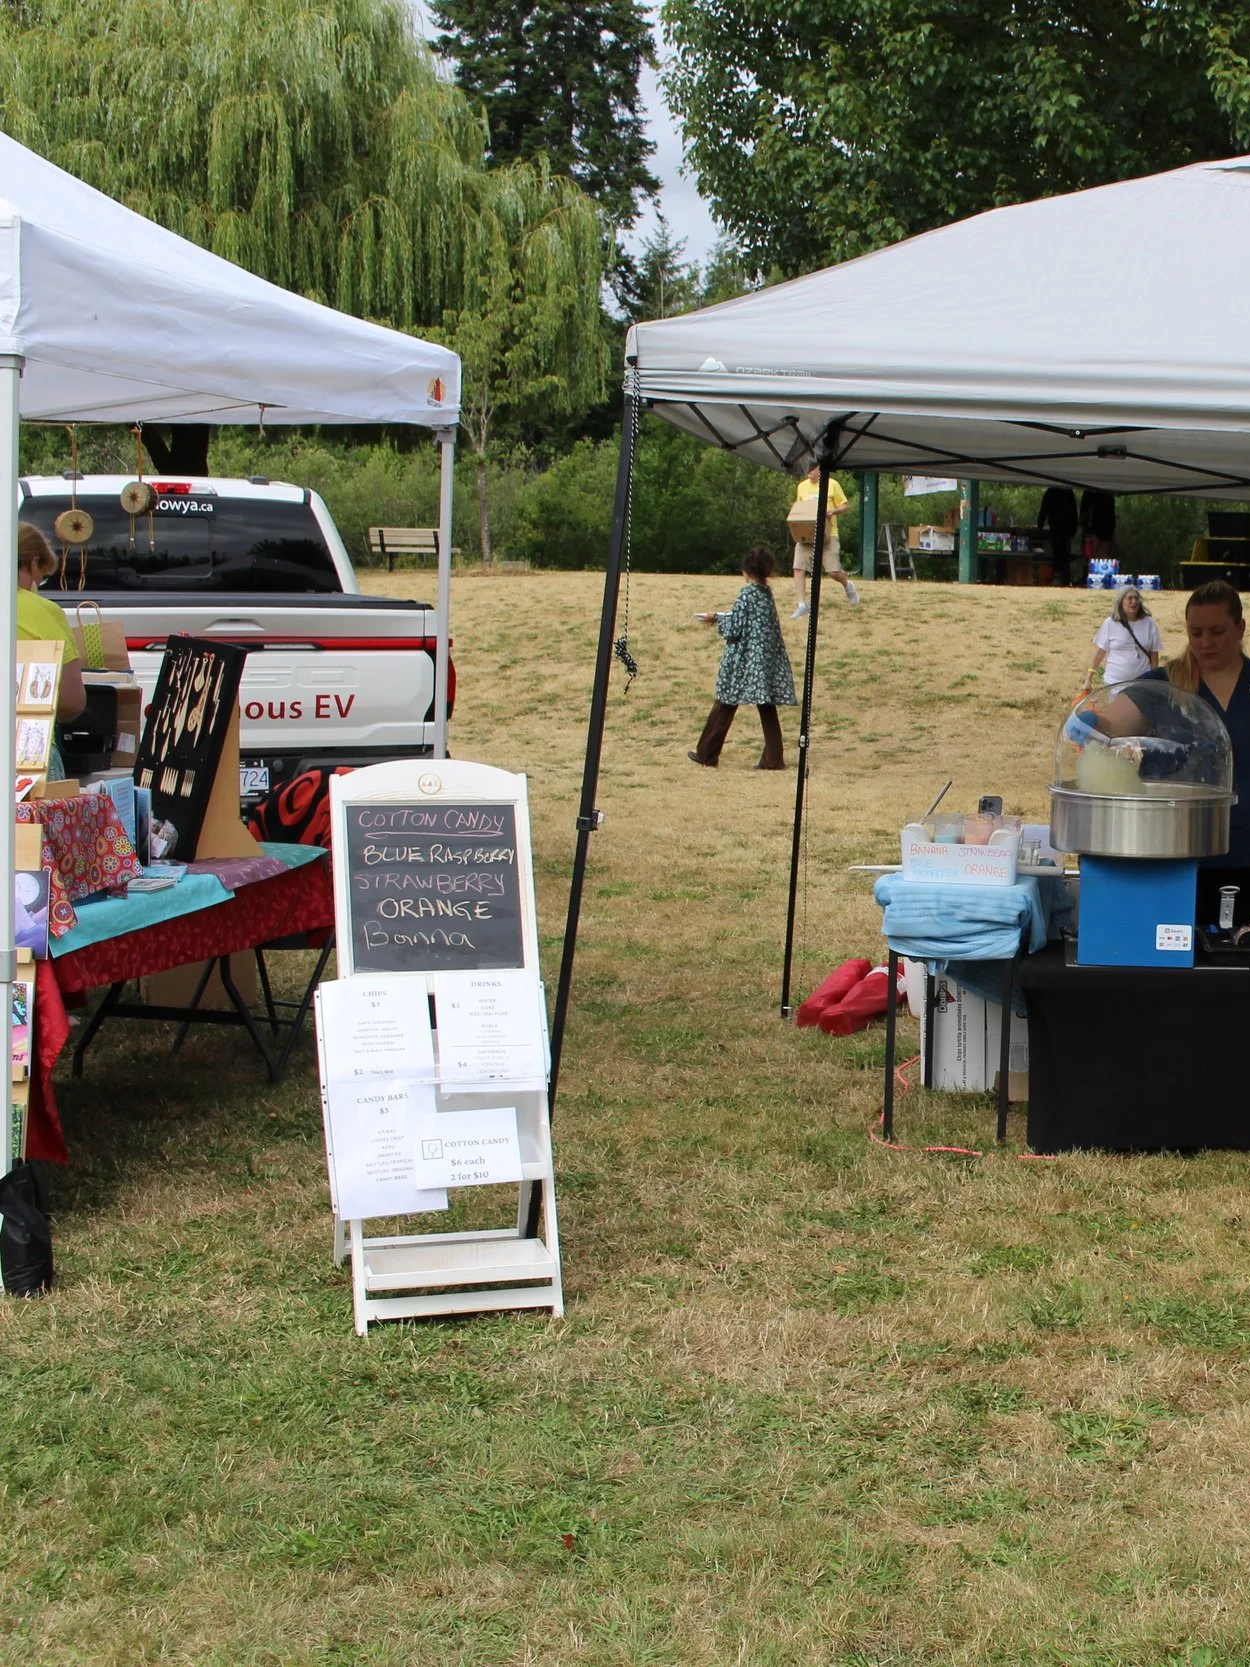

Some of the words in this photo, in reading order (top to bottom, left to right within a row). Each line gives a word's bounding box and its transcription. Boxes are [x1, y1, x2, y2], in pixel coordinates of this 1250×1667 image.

[239, 699, 303, 720] ous
[315, 694, 355, 718] EV
[240, 770, 268, 787] 724
[358, 810, 438, 828] COTTON
[443, 809, 505, 832] CANDY
[363, 845, 426, 865] BLUE
[910, 844, 949, 856] BANANA
[964, 863, 1008, 878] ORANGE
[353, 872, 505, 896] STRAWBERRY
[379, 897, 493, 920] ORANGE
[938, 980, 948, 1013] Doritos
[356, 1095, 386, 1104] CANDY
[387, 1092, 410, 1101] BARS
[379, 1107, 389, 1115] $3
[445, 1139, 480, 1148] COTTON
[481, 1137, 510, 1147] CANDY
[451, 1156, 462, 1167] $6
[464, 1156, 486, 1166] each
[451, 1173, 457, 1181] 2
[457, 1171, 471, 1181] for
[473, 1170, 489, 1180] $10
